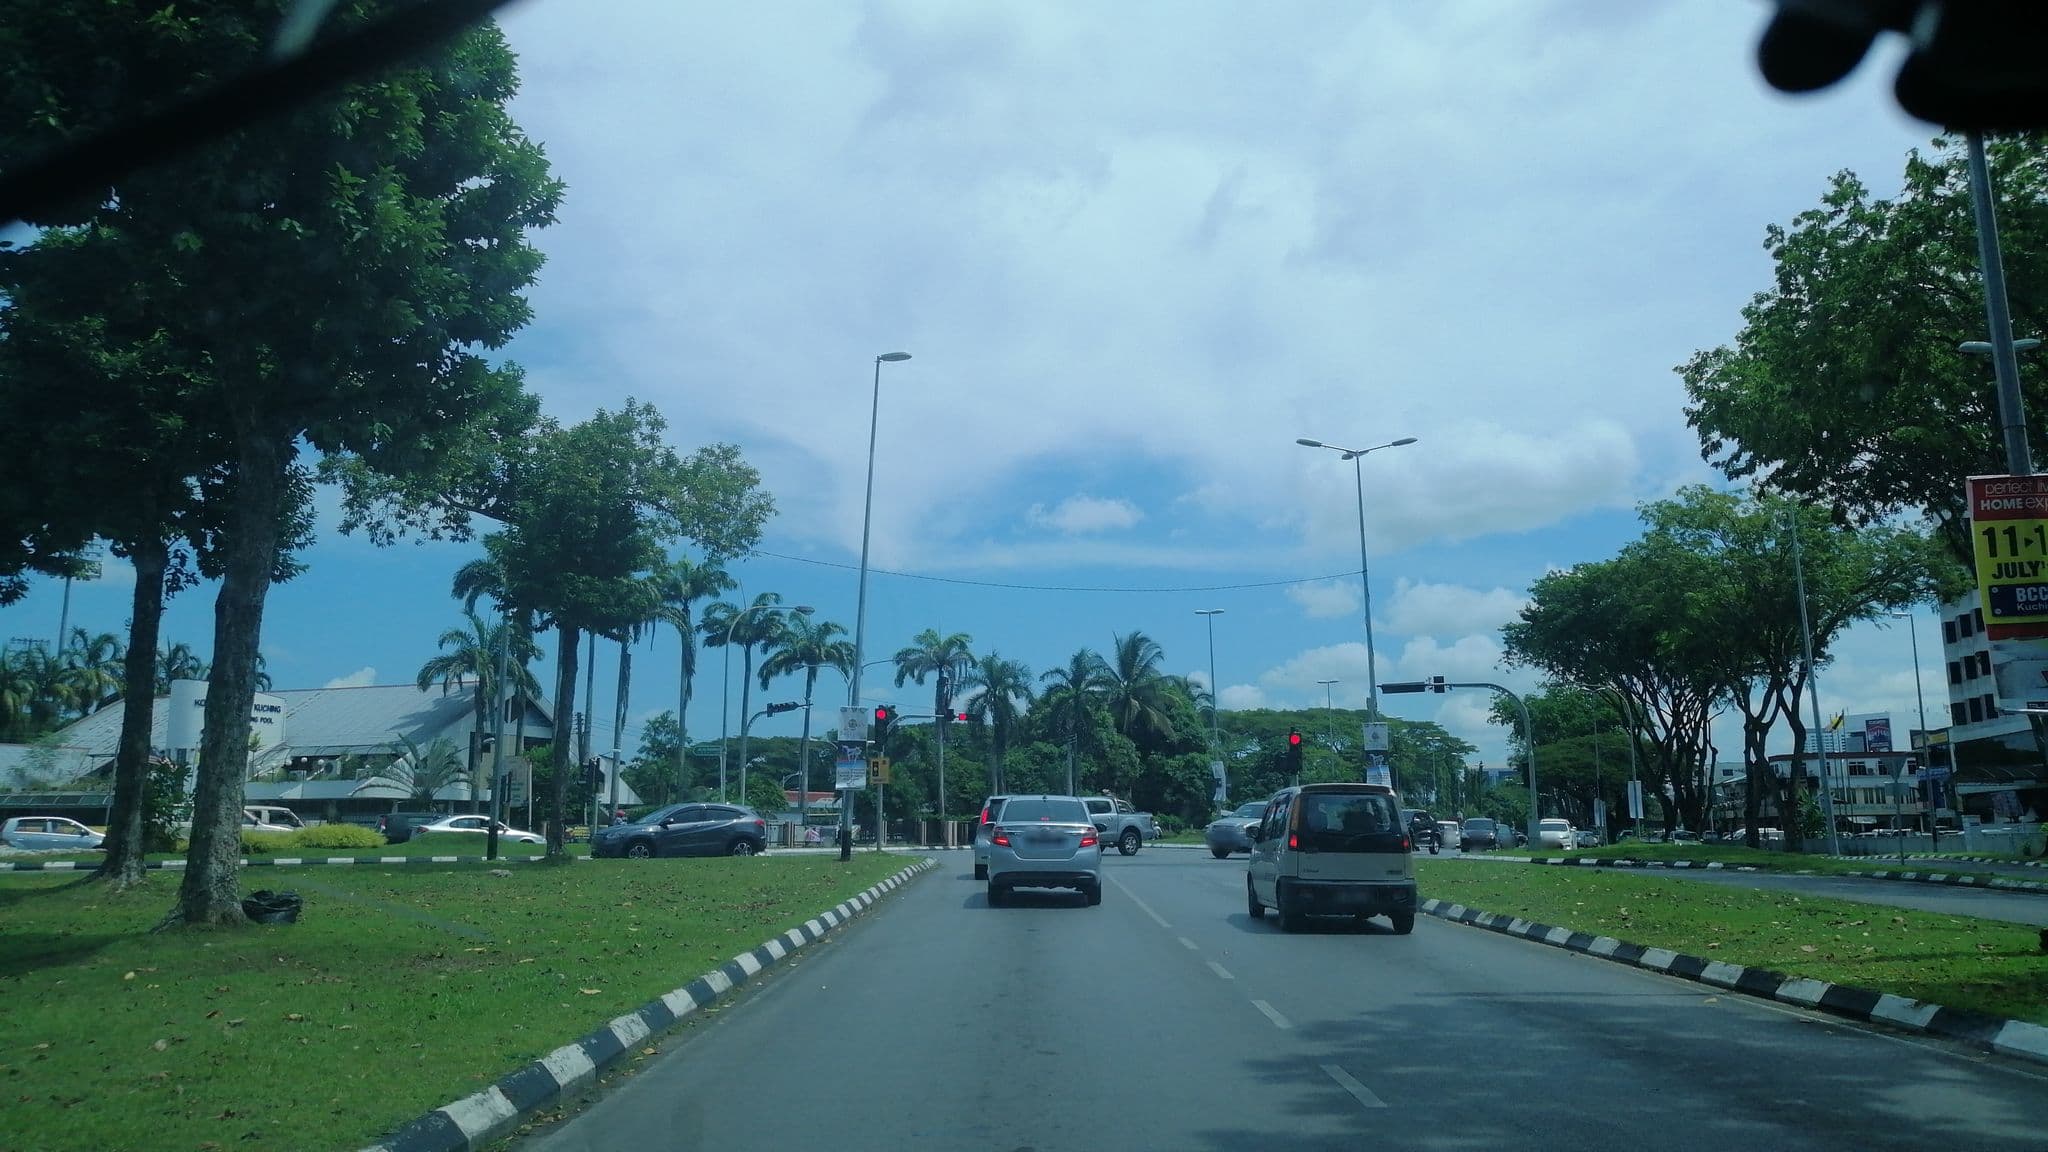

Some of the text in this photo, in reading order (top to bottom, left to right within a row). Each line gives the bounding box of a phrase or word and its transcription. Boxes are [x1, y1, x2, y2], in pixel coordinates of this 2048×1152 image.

[1985, 480, 2032, 498] perfect
[1980, 498, 2023, 511] HOME
[1982, 525, 2018, 557] 11
[253, 704, 282, 713] KUCHING
